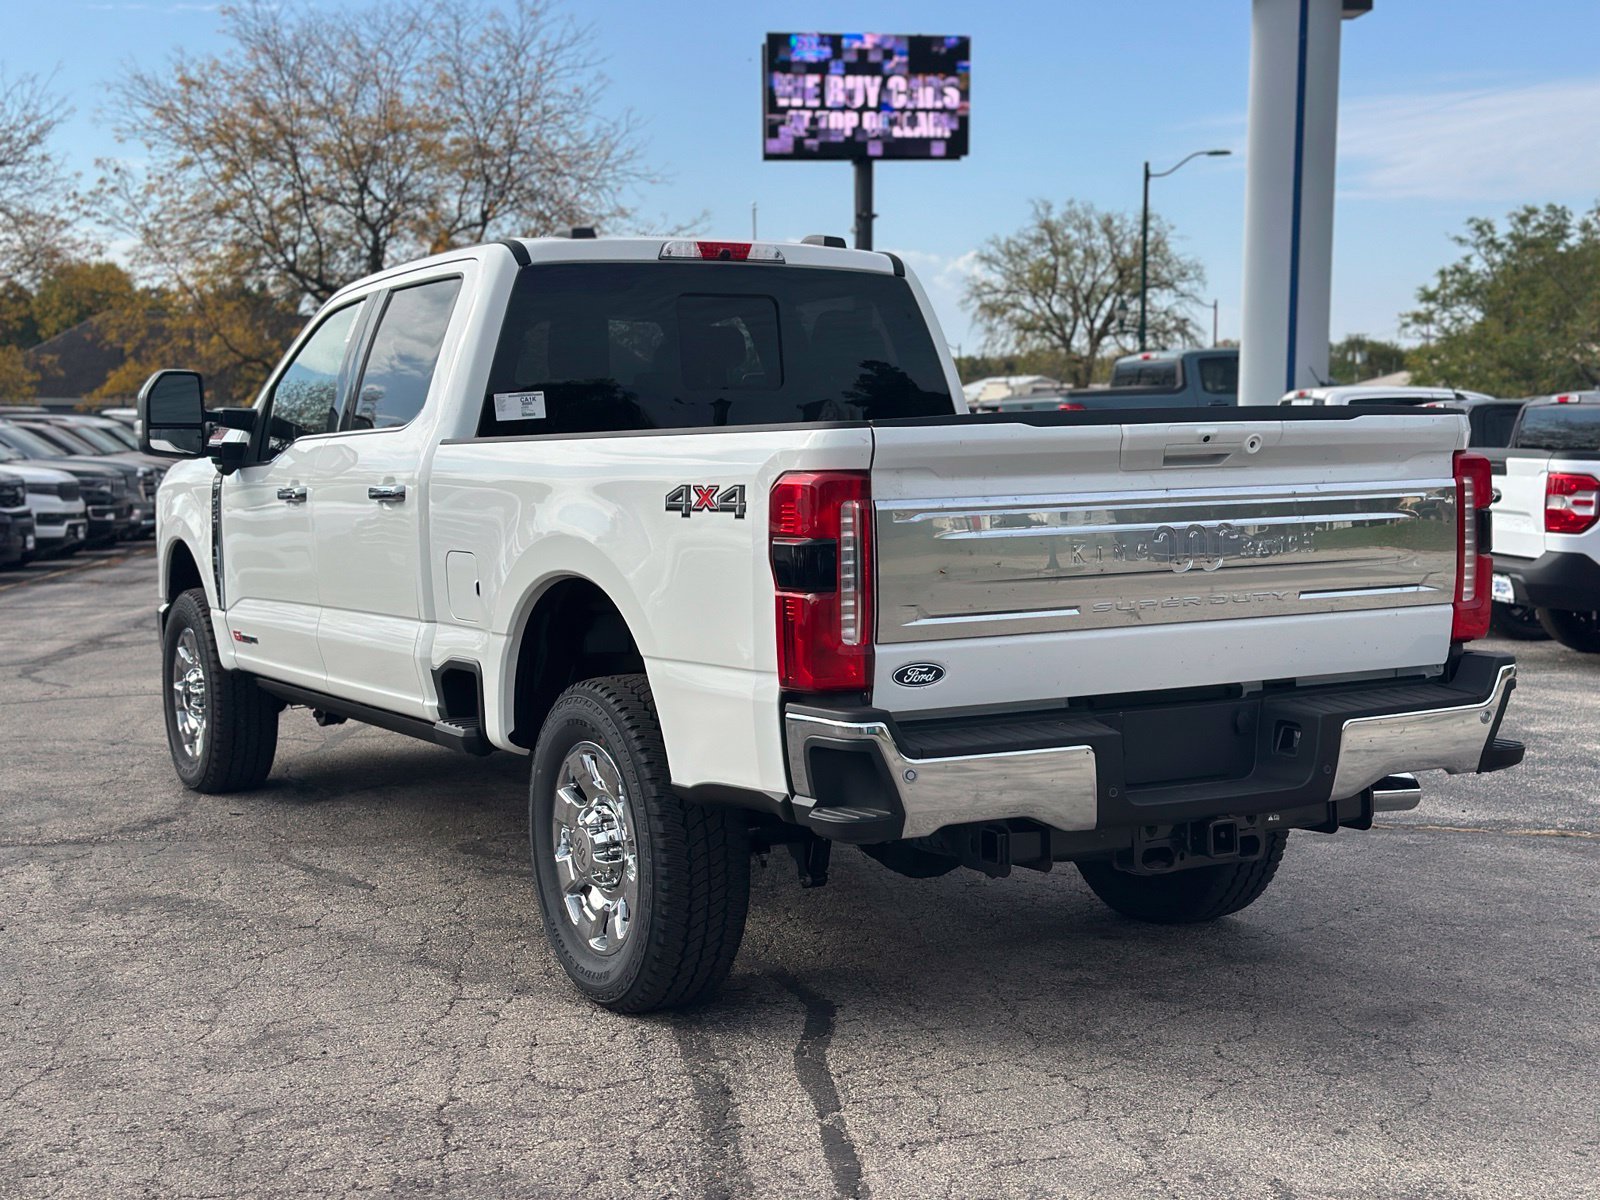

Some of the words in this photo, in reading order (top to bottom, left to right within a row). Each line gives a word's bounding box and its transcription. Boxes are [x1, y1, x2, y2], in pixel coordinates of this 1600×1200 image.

[824, 75, 883, 109] BUY
[814, 109, 859, 137] TOP
[1070, 543, 1149, 566] KING
[1092, 596, 1201, 614] SUPER
[1209, 591, 1290, 606] DUTY
[903, 667, 936, 683] Ford
